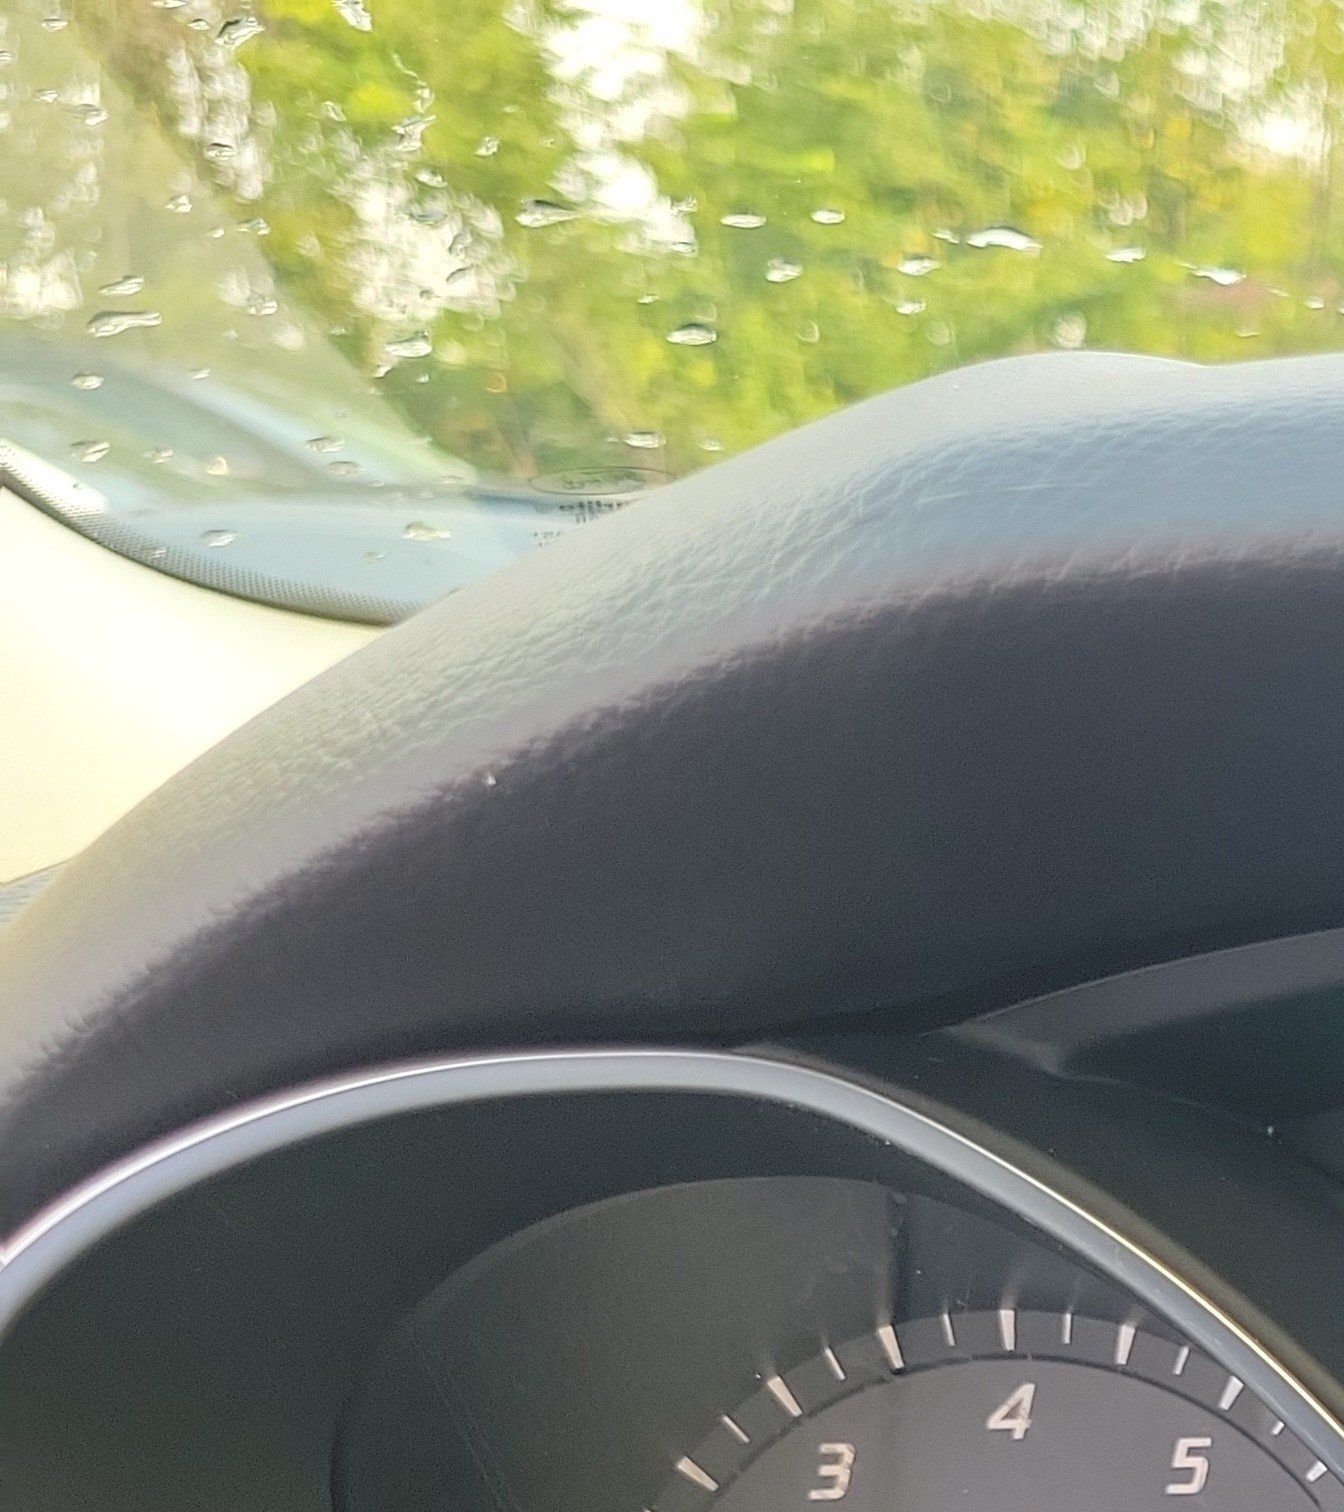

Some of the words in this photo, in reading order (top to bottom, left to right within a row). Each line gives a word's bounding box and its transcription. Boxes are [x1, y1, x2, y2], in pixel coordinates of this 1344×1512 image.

[987, 1384, 1034, 1439] 4
[809, 1443, 854, 1499] 3
[1167, 1438, 1211, 1493] 5
